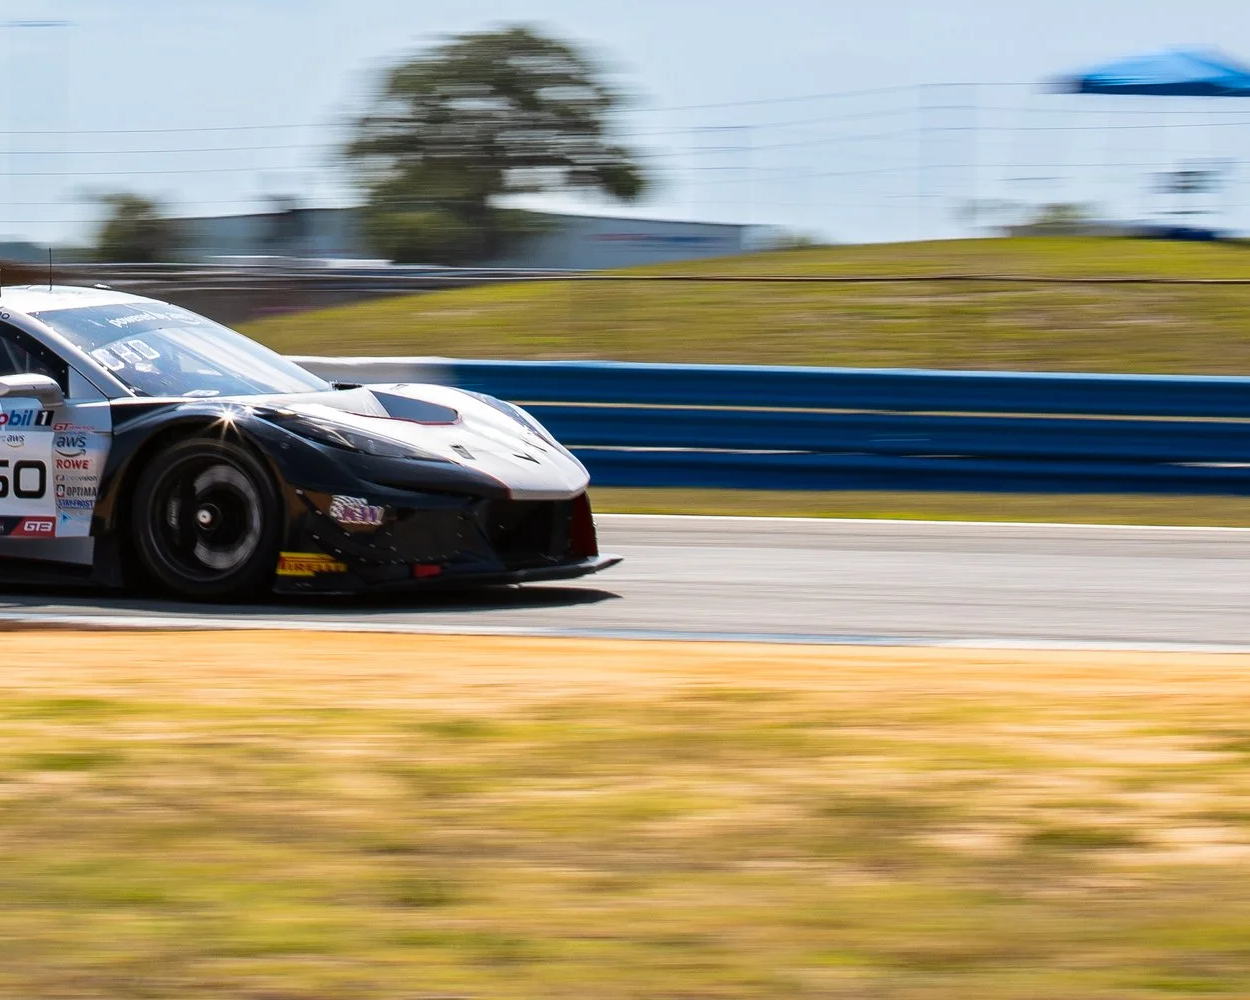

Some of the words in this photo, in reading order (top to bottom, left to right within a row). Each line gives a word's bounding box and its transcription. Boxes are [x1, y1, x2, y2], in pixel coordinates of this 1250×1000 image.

[6, 434, 25, 443] aws
[56, 436, 87, 448] aws
[56, 459, 90, 470] ROWE
[66, 486, 97, 497] OPTIMA
